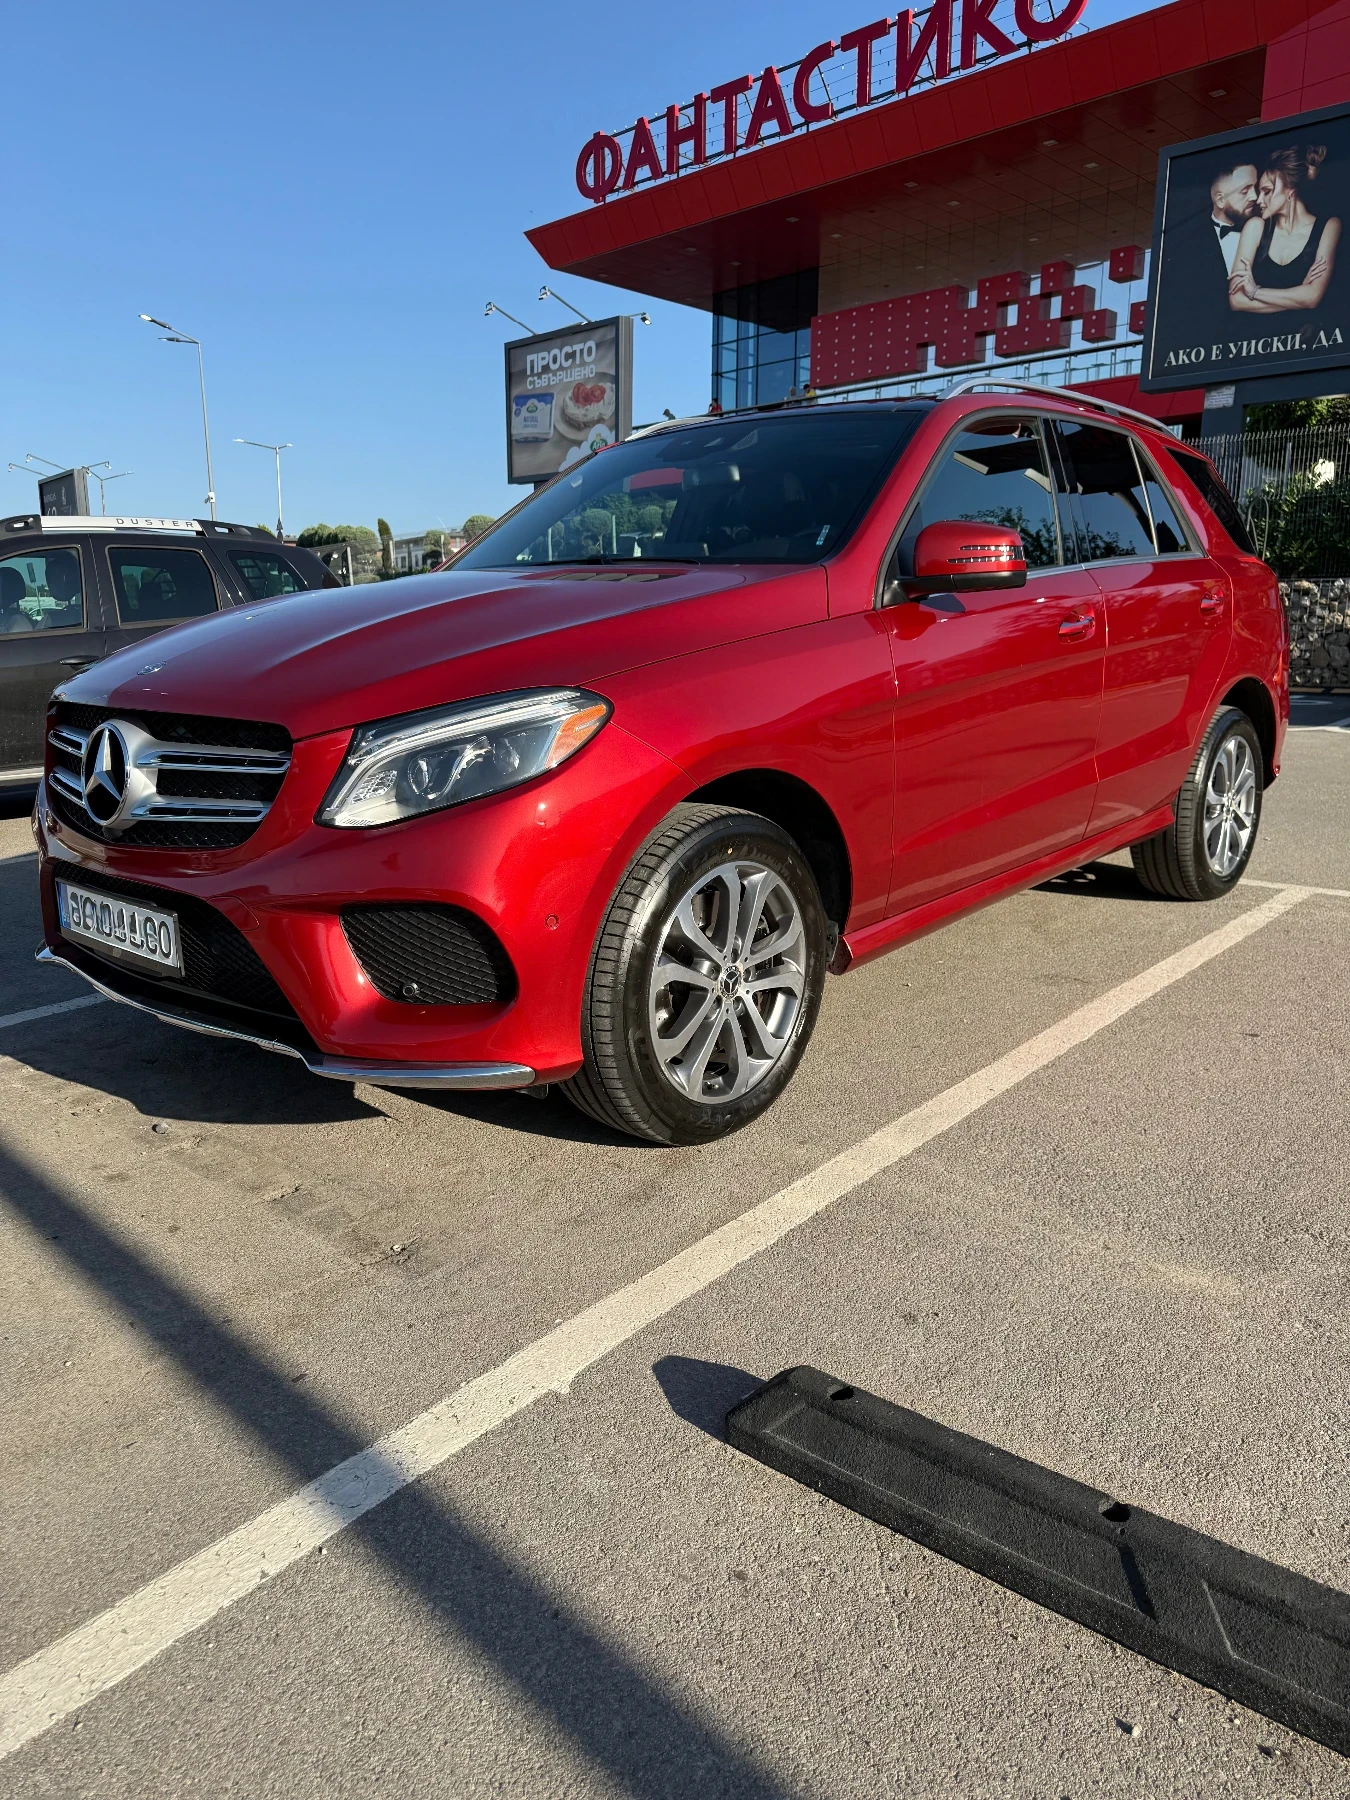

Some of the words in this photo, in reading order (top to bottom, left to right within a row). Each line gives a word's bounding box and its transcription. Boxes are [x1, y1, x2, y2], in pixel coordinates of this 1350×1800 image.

[526, 340, 596, 375] ПРОСТО
[1164, 346, 1205, 367] АКО
[1210, 344, 1223, 361] Е
[1228, 333, 1307, 359] УИСКИ,
[1312, 327, 1344, 350] ДА
[526, 364, 596, 389] СЪВЪРШЕНО
[116, 518, 194, 528] DUSTER
